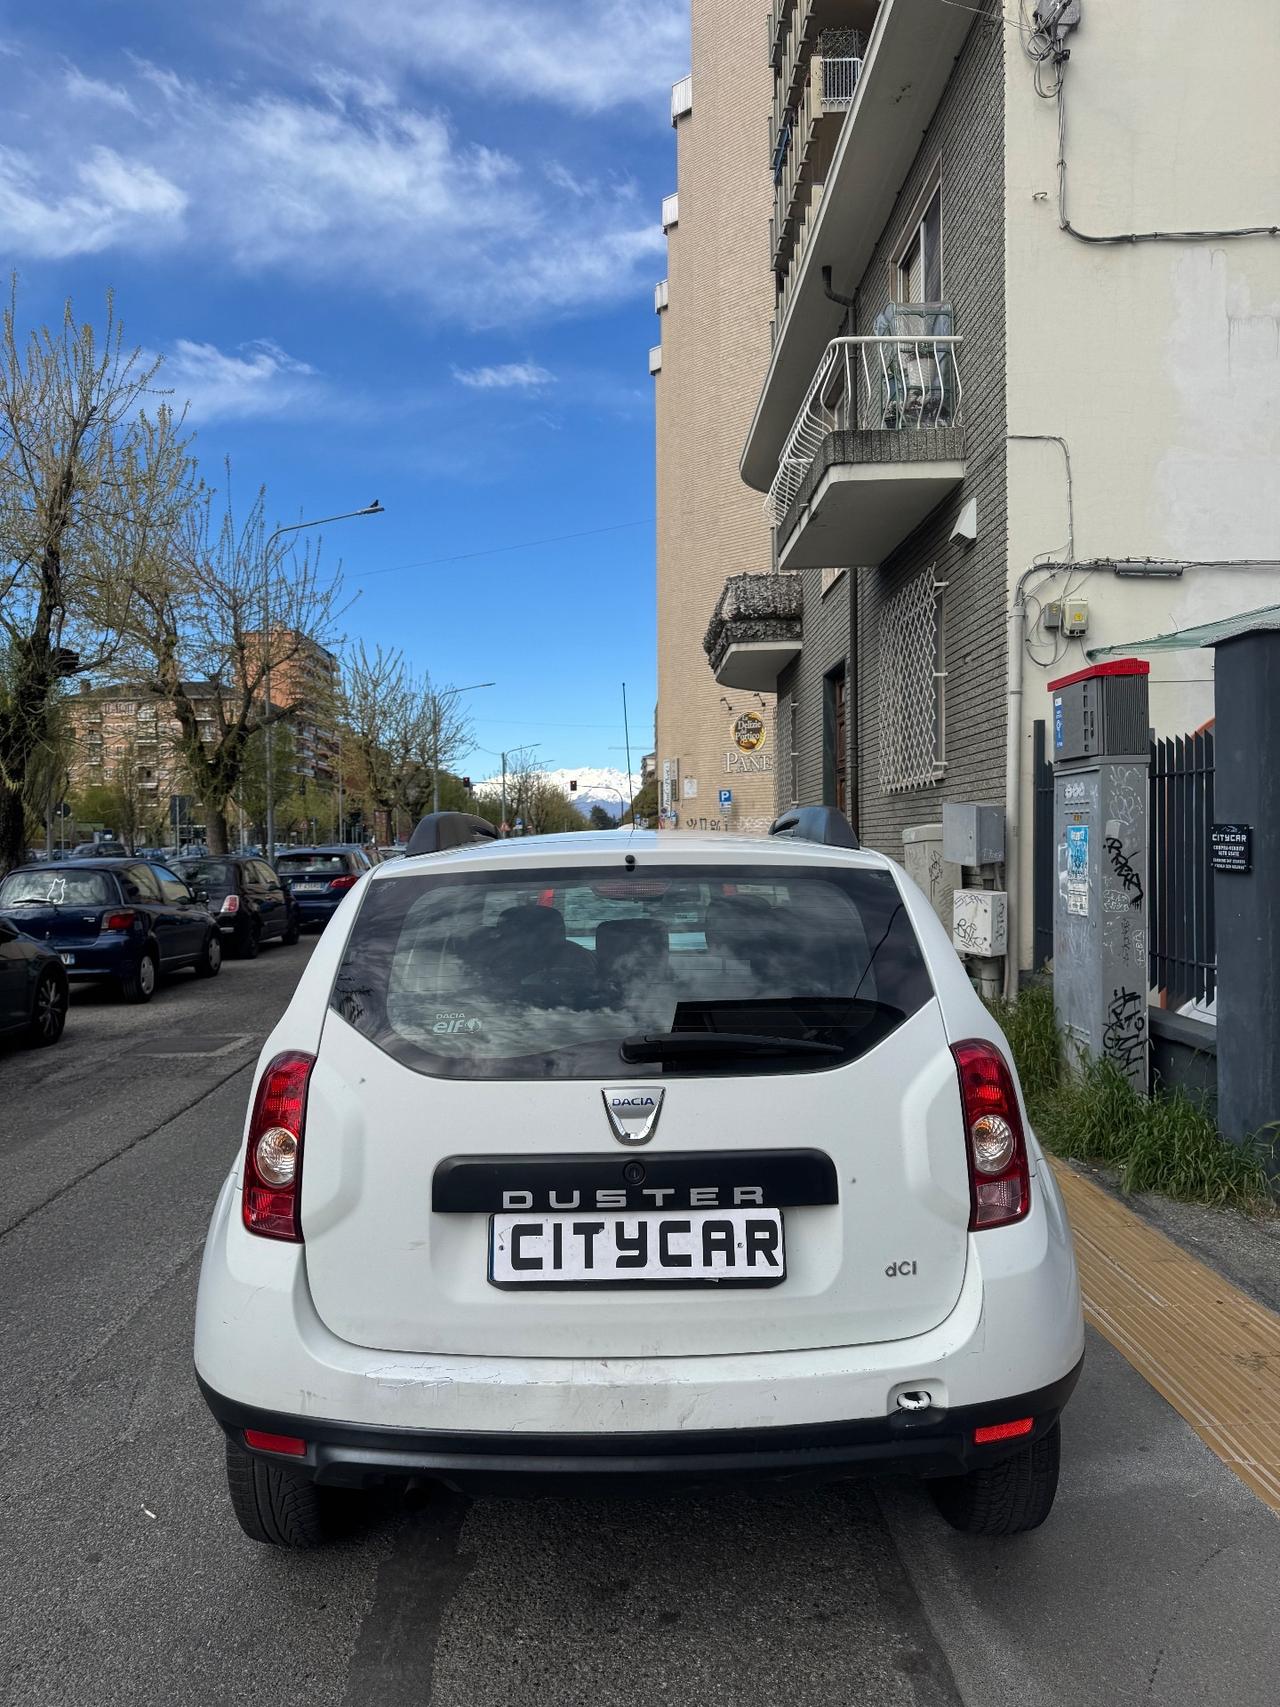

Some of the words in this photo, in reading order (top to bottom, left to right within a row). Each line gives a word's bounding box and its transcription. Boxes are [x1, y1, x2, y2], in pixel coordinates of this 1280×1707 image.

[738, 720, 761, 730] Delizie
[736, 731, 760, 741] Portico
[723, 752, 773, 773] PANE
[1212, 833, 1247, 842] CITYCAR
[432, 1020, 464, 1033] elf
[612, 1097, 655, 1107] DACIA
[502, 1186, 764, 1209] DUSTER
[510, 1219, 780, 1271] CITYCAR
